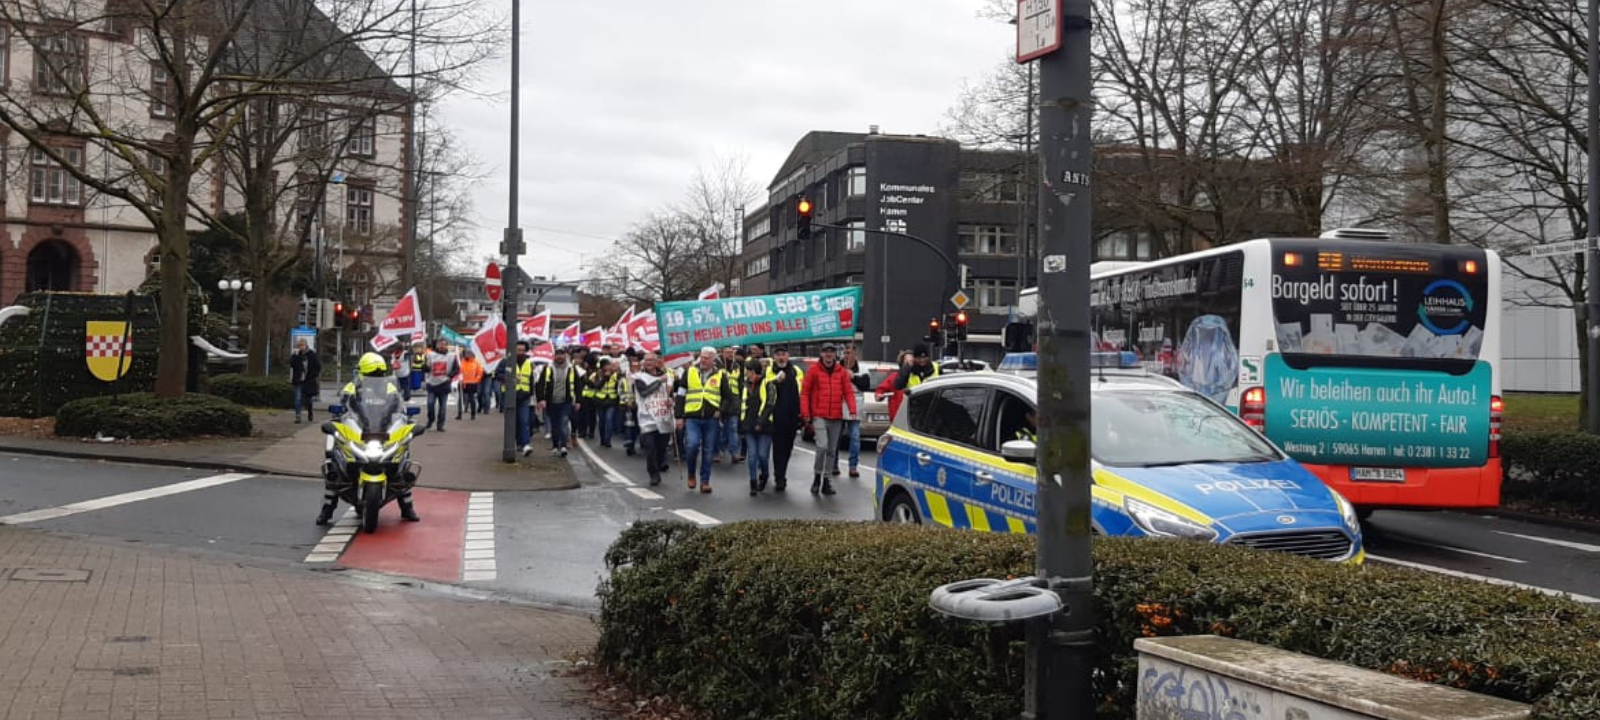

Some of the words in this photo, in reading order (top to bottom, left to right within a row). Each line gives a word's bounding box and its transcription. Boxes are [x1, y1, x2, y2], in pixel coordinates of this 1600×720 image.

[880, 183, 935, 193] Kommunales
[880, 207, 907, 215] Hamm
[1272, 274, 1334, 305] Bargeld
[1340, 275, 1387, 302] sofort
[1424, 296, 1466, 307] LEIHHAUS
[664, 306, 721, 328] 10,5%,
[722, 300, 773, 320] MIND.
[775, 296, 808, 314] 500
[811, 294, 822, 312] €
[825, 295, 855, 311] MEHR
[669, 331, 691, 346] IST
[694, 326, 723, 343] MEHR
[726, 321, 748, 338] FÜR
[751, 319, 774, 335] UNS
[776, 317, 808, 333] ALLE!
[1280, 377, 1305, 399] Wir
[1310, 377, 1371, 401] beleihen
[1376, 381, 1410, 403] auch
[1415, 381, 1433, 404] ihr
[1438, 383, 1477, 405] Auto!
[1290, 405, 1338, 429] SERIÖS
[1351, 411, 1428, 433] KOMPETENT
[1440, 415, 1467, 434] FAIR
[1283, 441, 1317, 456] Westring
[1319, 441, 1324, 454] 2
[1332, 443, 1359, 455] 59065
[1361, 444, 1386, 456] Hamm
[1407, 445, 1413, 457] 0
[1415, 445, 1435, 457] 2381
[1446, 446, 1457, 458] 33
[1459, 447, 1470, 458] 22
[991, 482, 1035, 511] POLIZEI
[1194, 478, 1302, 495] POLIZEI
